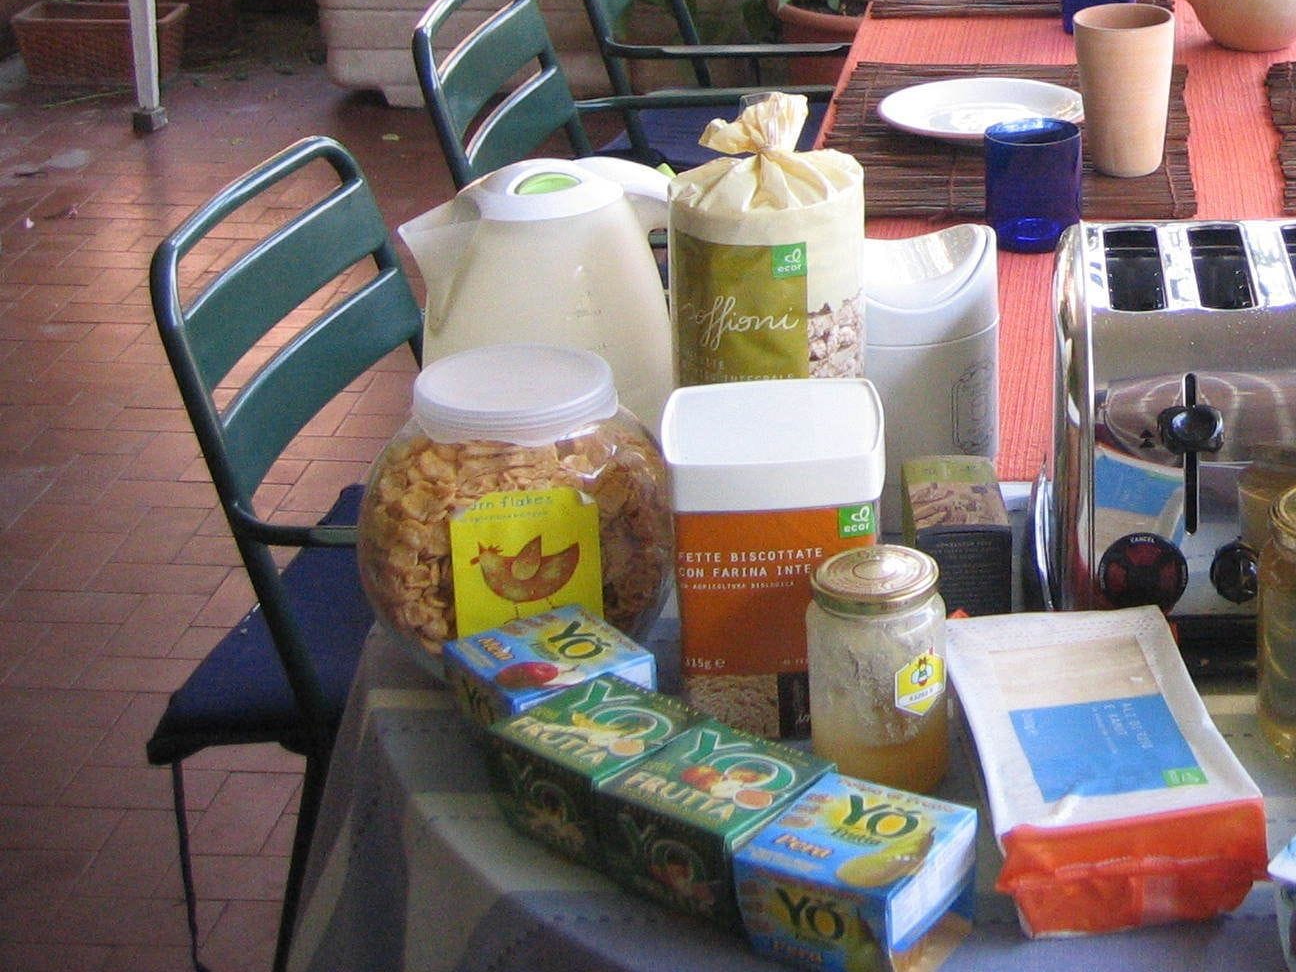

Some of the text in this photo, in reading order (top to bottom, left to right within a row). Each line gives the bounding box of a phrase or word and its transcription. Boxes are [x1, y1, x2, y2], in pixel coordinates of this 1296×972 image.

[844, 522, 870, 533] ecor
[731, 548, 823, 563] BISCOTTATE
[679, 563, 811, 578] CON FARINA INTE
[623, 771, 735, 821] FRUTTA
